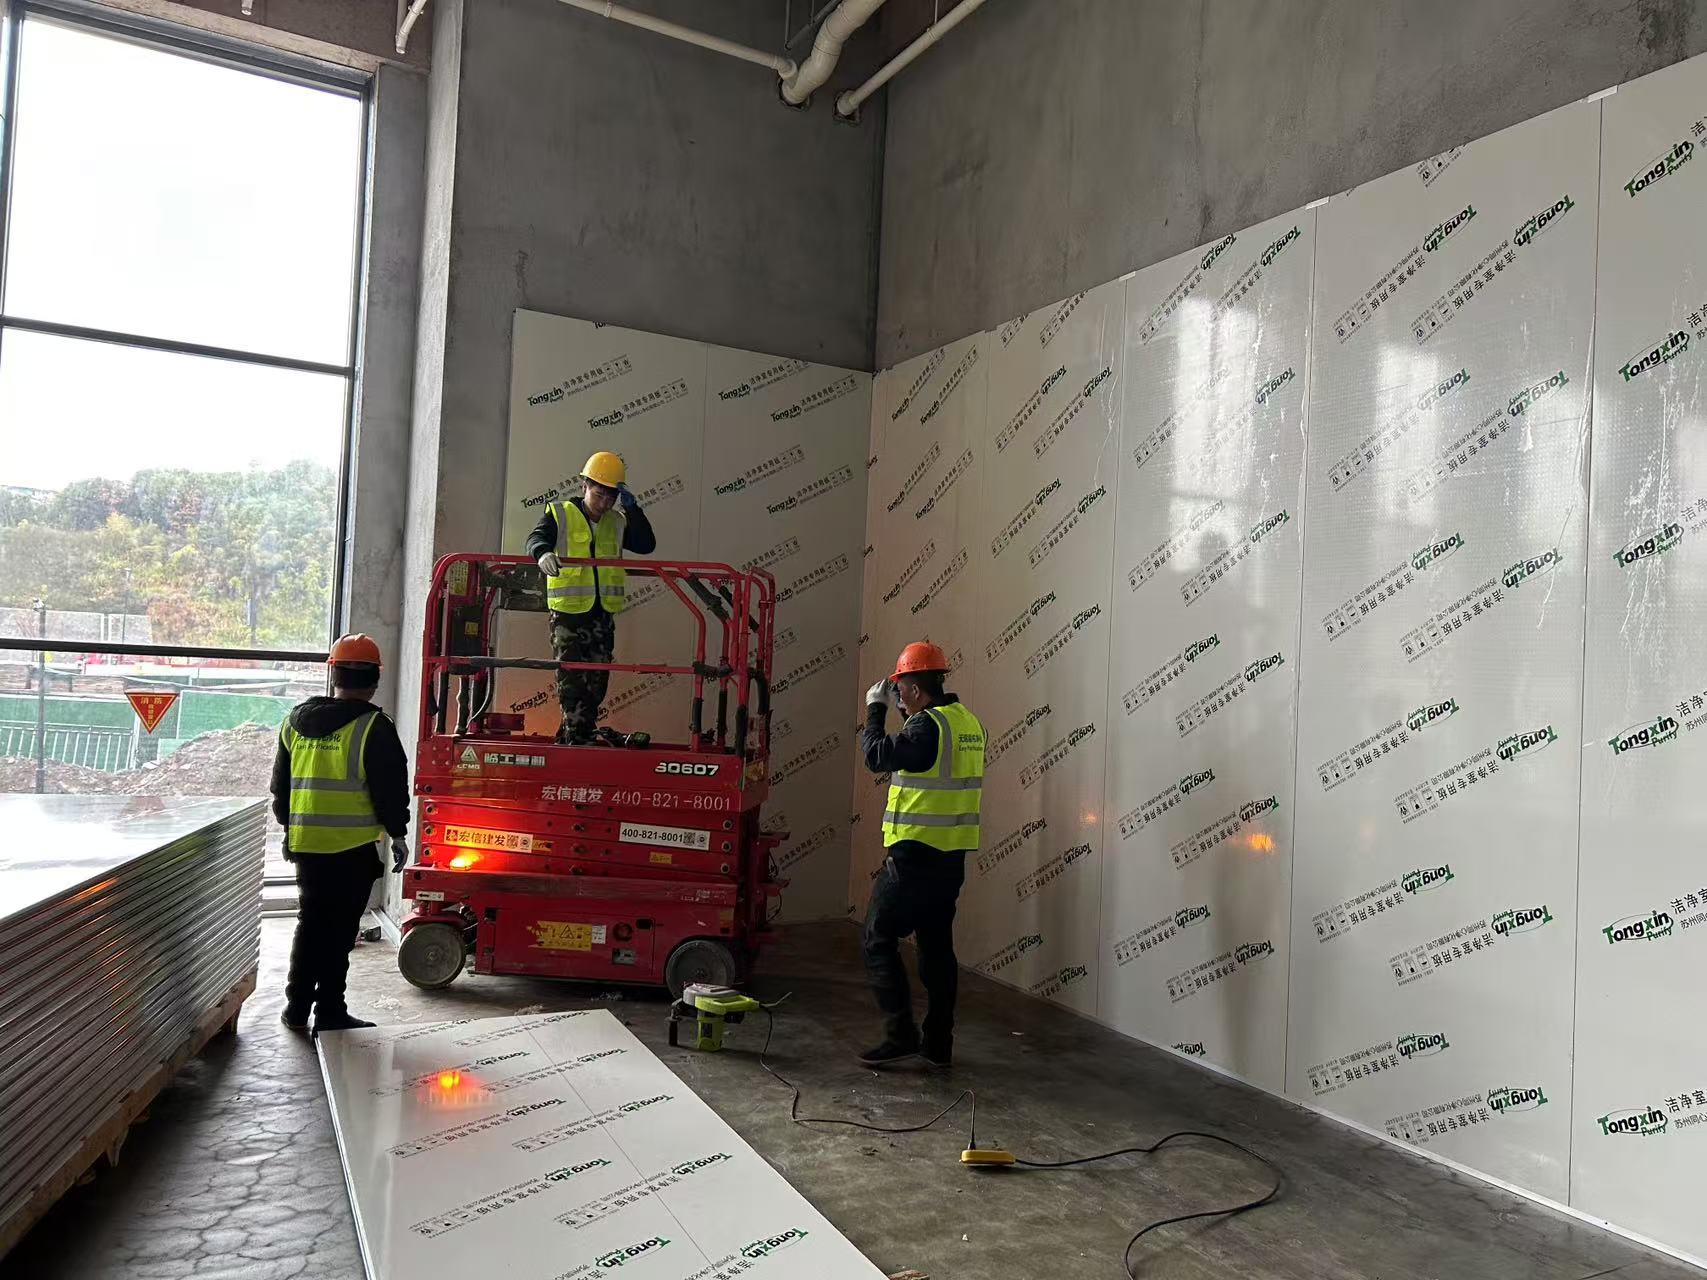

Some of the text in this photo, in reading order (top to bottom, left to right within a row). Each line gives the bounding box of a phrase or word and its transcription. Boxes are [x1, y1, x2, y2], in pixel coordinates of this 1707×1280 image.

[1623, 139, 1690, 199] Tongxin
[1426, 203, 1476, 252] Tongxin
[1517, 194, 1574, 247] Tongxin
[1203, 231, 1236, 270] Tongxin
[1263, 225, 1300, 267] Tongxin
[1369, 254, 1425, 310] 洁净室专用板
[1451, 249, 1516, 309] 洁净室专用板
[1618, 330, 1685, 383] Tongxin
[527, 386, 563, 406] Tongxin
[718, 383, 749, 401] Tongxin
[1084, 366, 1111, 398] Tongxin
[1257, 366, 1294, 405] Tongxin
[1511, 370, 1568, 417] Tongxin
[587, 409, 622, 429] Tongxin
[771, 404, 800, 423] Tongxin
[521, 487, 557, 509] Tongxin
[714, 477, 745, 496] Tongxin
[1079, 485, 1105, 514] Tongxin
[766, 495, 796, 515] Tongxin
[1252, 508, 1289, 543] Tongxin
[1415, 531, 1464, 570] Tongxin
[1613, 523, 1679, 569] Tongxin
[1506, 547, 1563, 588] Tongxin
[1358, 570, 1414, 615] 洁净室专用板
[1074, 603, 1100, 630] Tongxin
[1441, 588, 1505, 635] 洁净室专用板
[1186, 632, 1219, 662] Tongxin
[1247, 651, 1284, 682] Tongxin
[510, 691, 547, 713] Tongxin
[1410, 697, 1459, 731] Tongxin
[1676, 691, 1707, 716] 洁净
[1069, 722, 1095, 746] Tongxin
[1501, 725, 1558, 761] Tongxin
[1607, 716, 1674, 756] Tongxin
[1353, 730, 1409, 769] 洁净室专用板
[1182, 767, 1214, 794] Tongxin
[1436, 760, 1499, 801] 洁净室专用板
[541, 785, 730, 811] 宏信建发 400-821-8001
[1242, 795, 1279, 823] Tongxin
[459, 831, 506, 847] 宏信建发
[621, 829, 684, 843] 400-821-8001
[1065, 842, 1091, 865] Tongxin
[1405, 864, 1454, 894] Tongxin
[1177, 904, 1210, 928] Tongxin
[1348, 891, 1403, 925] 洁净室专用板
[1495, 905, 1552, 936] Tongxin
[1680, 913, 1707, 929] 苏州同
[1602, 911, 1669, 945] Tongxin
[1237, 940, 1274, 965] Tongxin
[1430, 933, 1494, 967] 洁净室专用板
[1061, 964, 1087, 985] Tongxin
[1399, 1032, 1449, 1059] Tongxin
[1343, 1054, 1398, 1081] 洁净室专用板
[511, 1098, 567, 1118] Tongxin
[622, 1094, 674, 1114] Tongxin
[1490, 1087, 1547, 1114] Tongxin
[1425, 1108, 1489, 1135] 洁净室专用板
[1597, 1106, 1663, 1135] Tongxin
[550, 1158, 612, 1182] Tongxin
[677, 1152, 733, 1175] Tongxin
[601, 1236, 671, 1269] Tongxin
[748, 1227, 809, 1260] Tongxin
